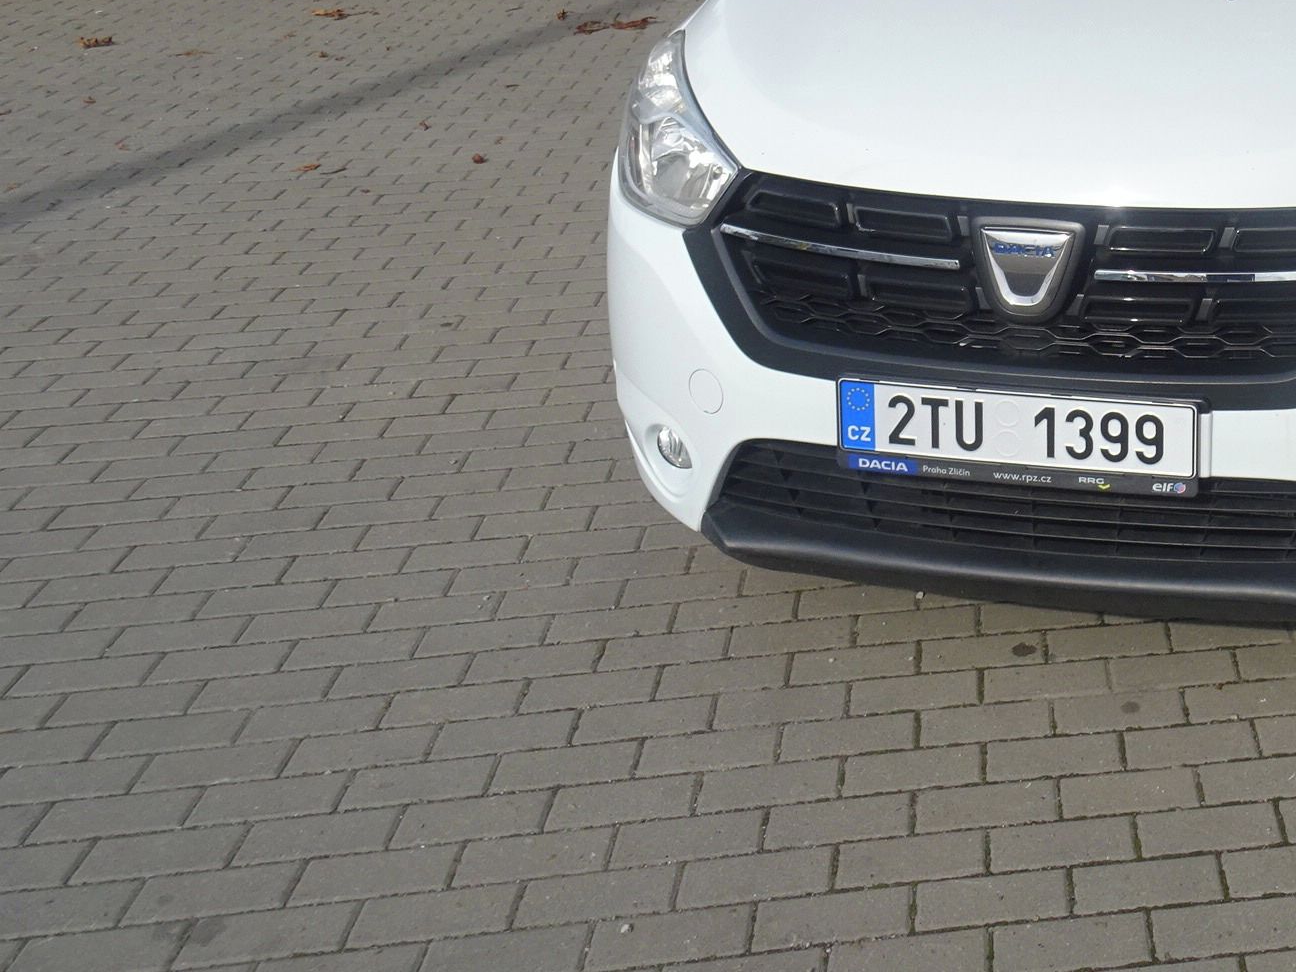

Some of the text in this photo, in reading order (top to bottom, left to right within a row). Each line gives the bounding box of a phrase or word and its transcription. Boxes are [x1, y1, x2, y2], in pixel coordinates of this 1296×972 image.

[847, 425, 871, 443] CZ
[888, 394, 1165, 465] 2TU 1399
[858, 458, 909, 472] DACIA
[922, 465, 947, 475] Praha
[948, 466, 971, 477] Zličín
[993, 471, 1053, 484] www.rpz.cz
[1078, 476, 1105, 485] RRG
